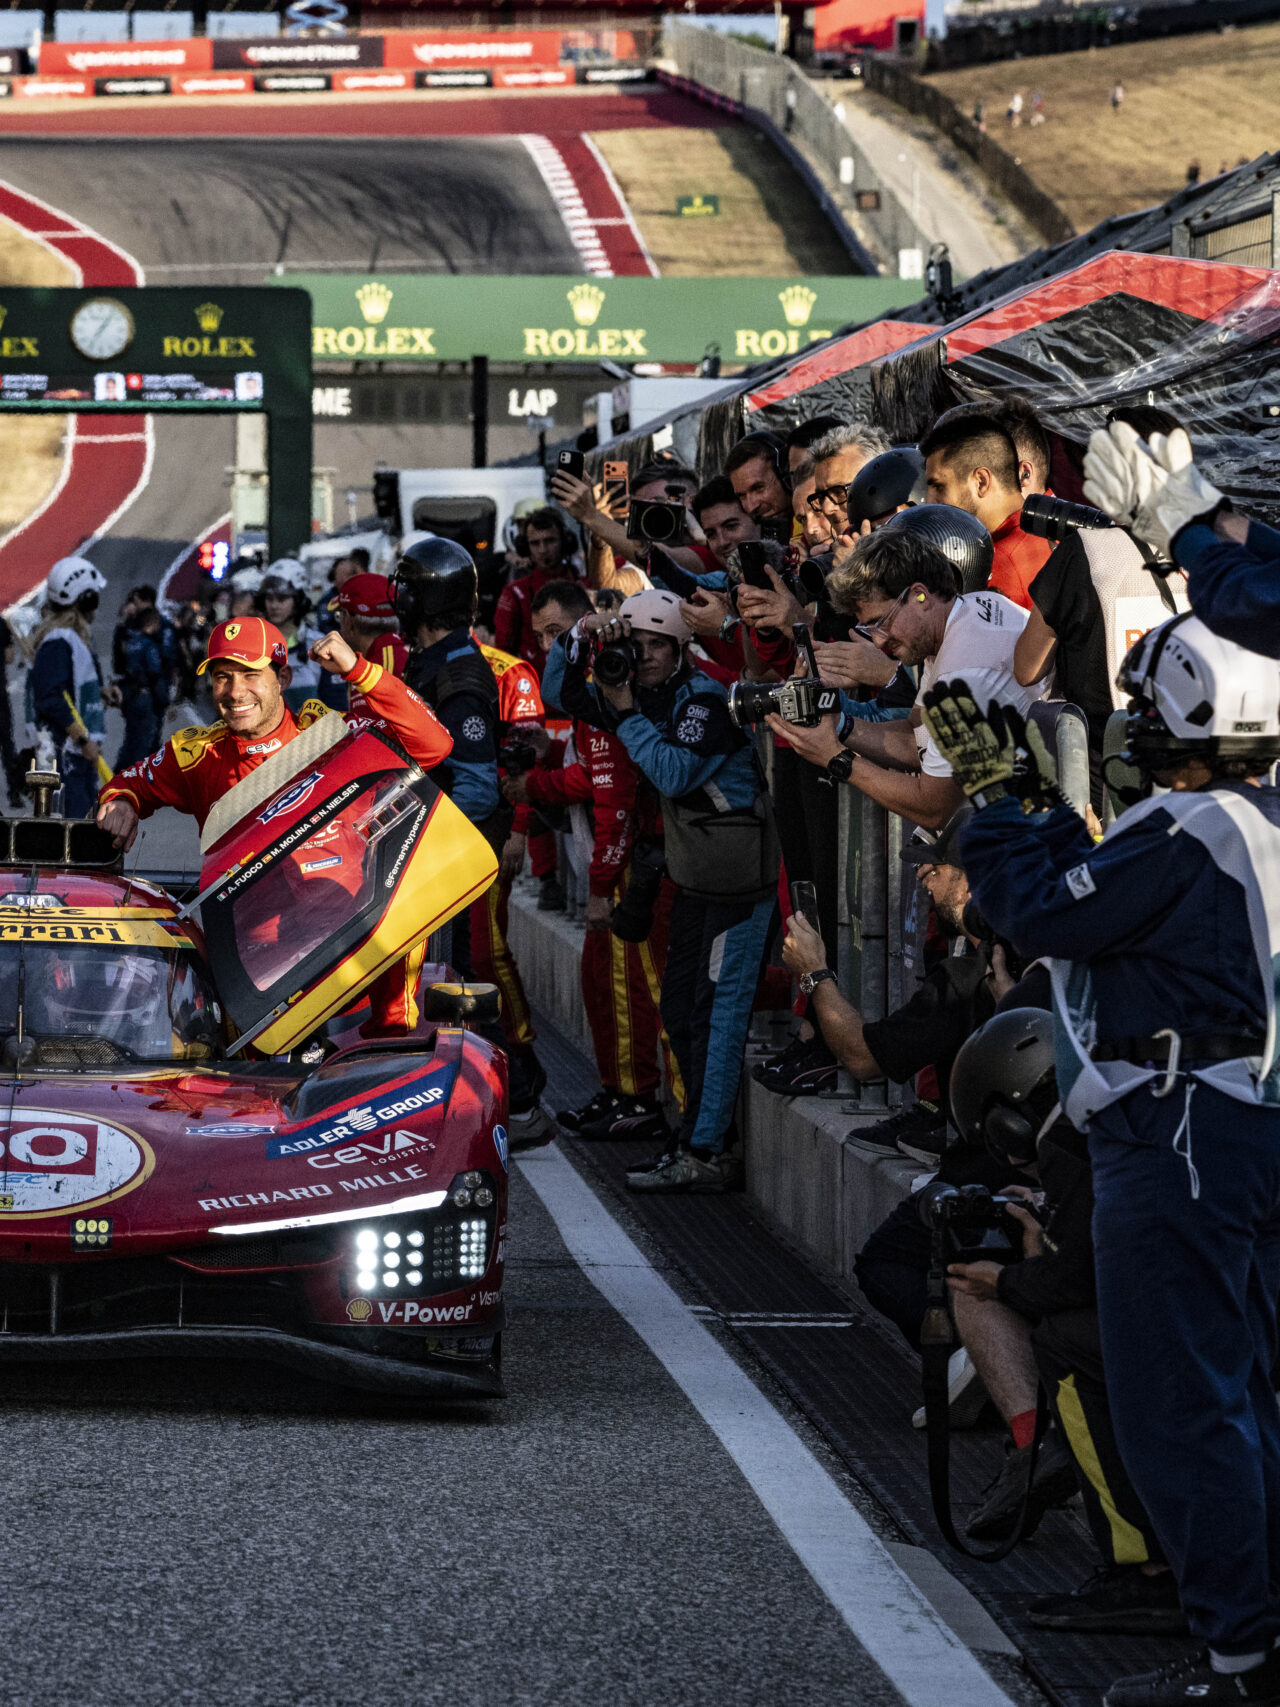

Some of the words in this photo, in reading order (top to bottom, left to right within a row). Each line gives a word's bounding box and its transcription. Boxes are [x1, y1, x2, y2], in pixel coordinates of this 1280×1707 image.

[163, 337, 256, 357] ROLEX
[312, 327, 436, 355] ROLEX
[523, 328, 647, 356] ROLEX
[312, 387, 352, 416] ME
[508, 387, 557, 417] LAP
[226, 885, 238, 895] A.
[234, 861, 264, 888] FUOCO
[270, 847, 283, 857] M.
[280, 822, 312, 849] MOLINA
[319, 807, 331, 819] N.
[327, 782, 360, 811] NIELSEN
[384, 804, 428, 888] @FerrariHypercar
[279, 1125, 354, 1155] ADLER
[375, 1086, 445, 1122] GROUP
[370, 1142, 437, 1166] LOGISTICS
[197, 1183, 334, 1212] RICHARD
[338, 1163, 428, 1192] MILLE
[378, 1302, 473, 1323] V-Power
